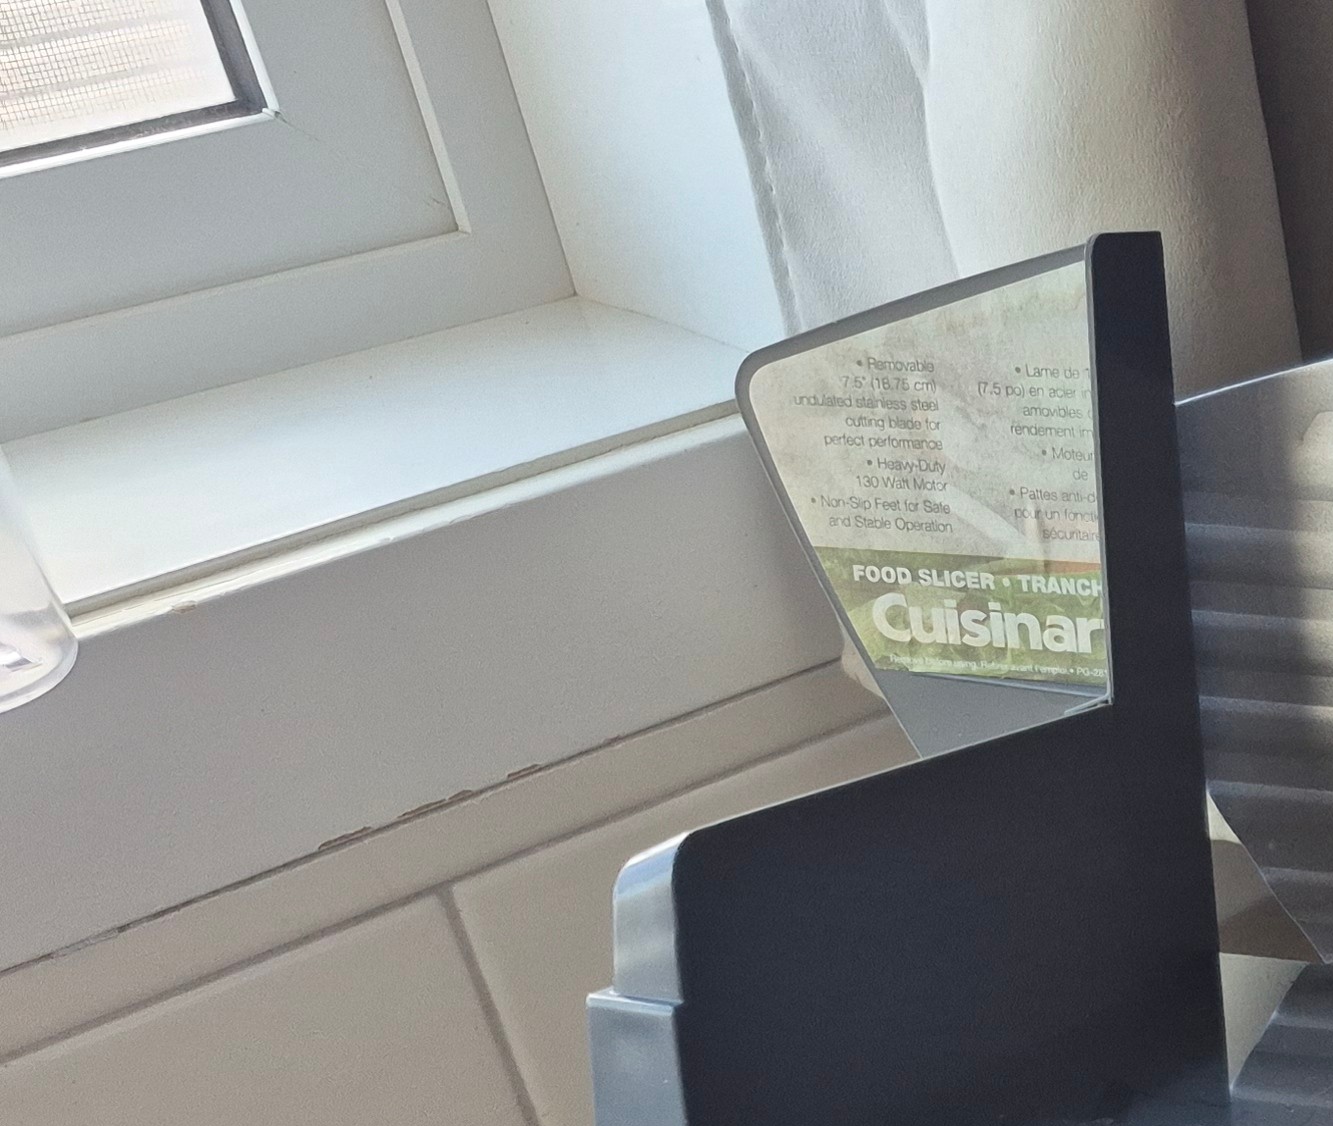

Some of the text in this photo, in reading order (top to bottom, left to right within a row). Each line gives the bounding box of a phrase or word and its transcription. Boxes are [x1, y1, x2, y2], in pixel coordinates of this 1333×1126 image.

[867, 357, 935, 373] Removable
[1025, 363, 1060, 378] Lame
[1063, 366, 1080, 379] de
[913, 379, 937, 393] cm)
[977, 381, 1001, 397] (7.5
[1005, 383, 1025, 398] po)
[1029, 386, 1045, 397] en
[1048, 385, 1076, 398] acier
[793, 394, 939, 411] undulated stainless steel
[1022, 405, 1083, 419] amovibles
[845, 415, 941, 431] cutting blade for
[1010, 423, 1076, 438] rendement
[823, 433, 943, 451] perfect performance
[1051, 446, 1094, 461] Moteur
[877, 457, 946, 475] Heavy-Duty
[1072, 468, 1089, 481] de
[856, 475, 948, 491] 130 Watt Motor
[1020, 486, 1058, 501] Pattes
[820, 495, 951, 514] Non-Slip Feet for Safe
[1045, 509, 1060, 521] un
[829, 514, 954, 533] and Stable Operation
[852, 564, 913, 586] FOOD
[918, 568, 996, 591] SLICER
